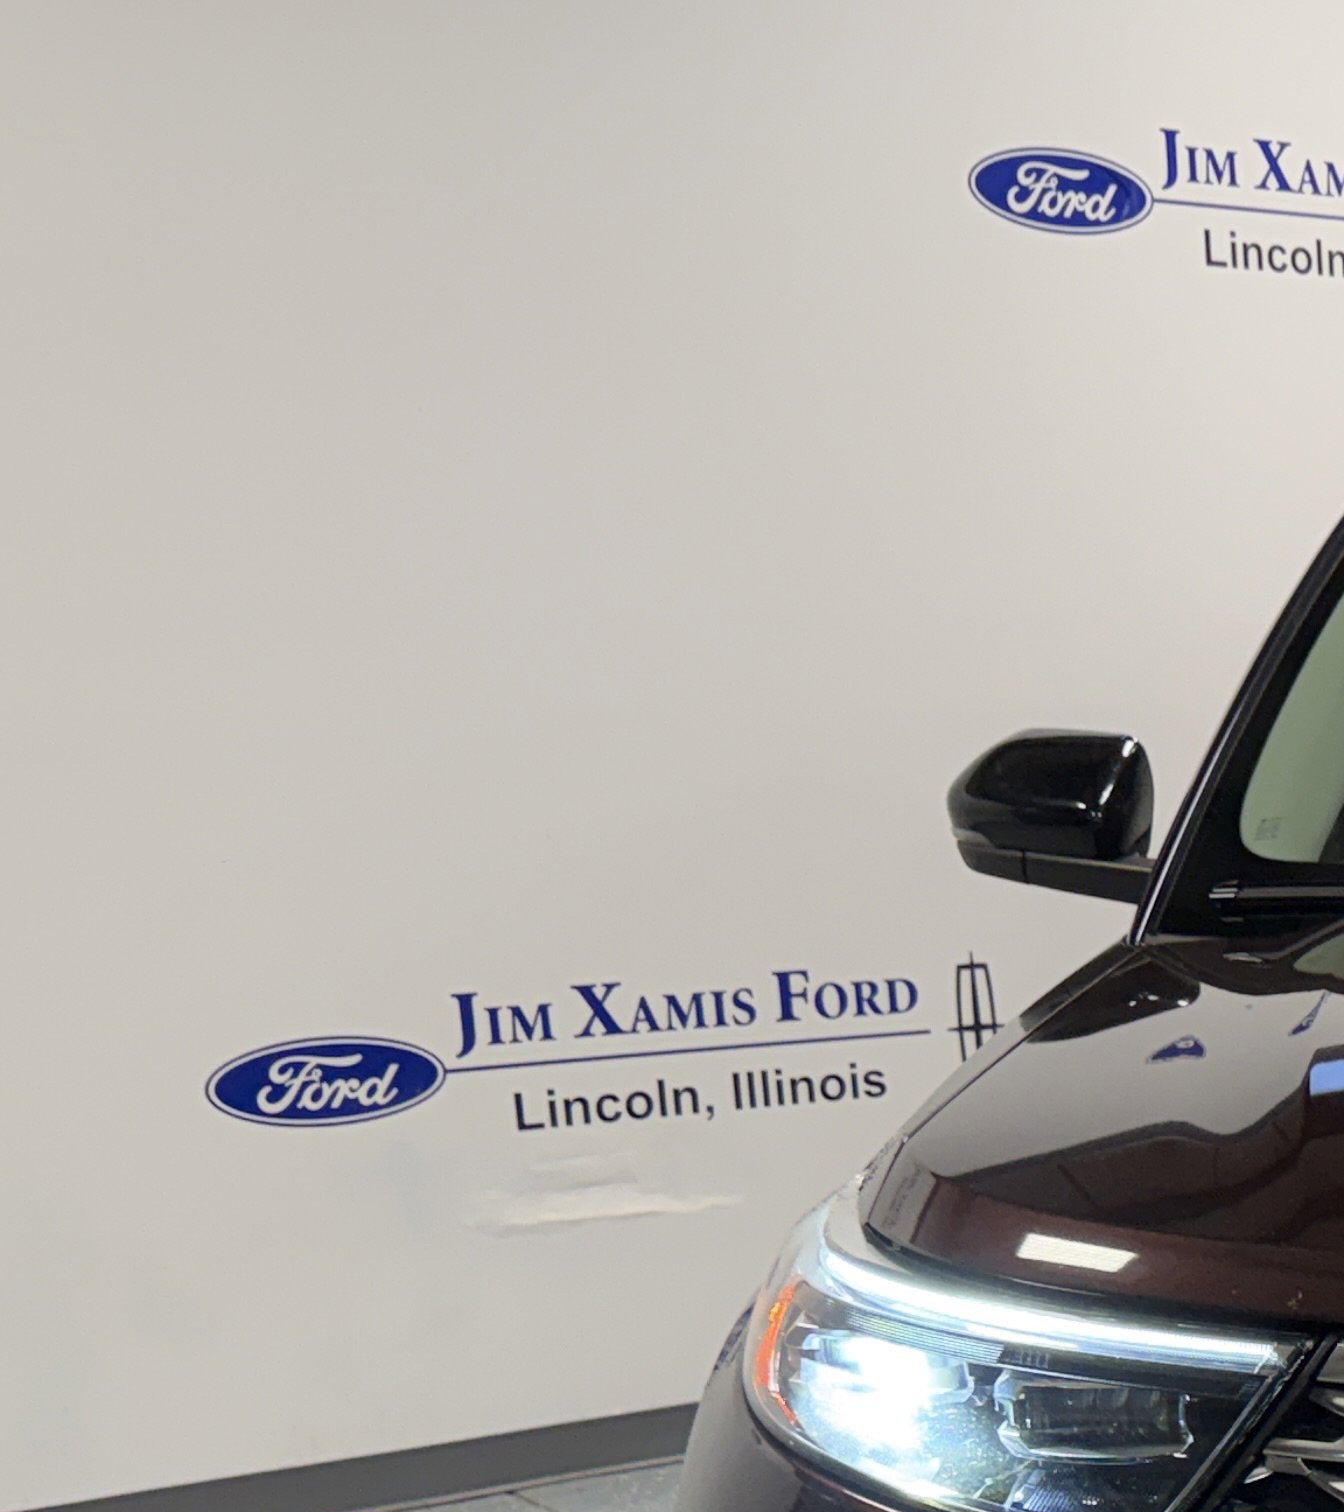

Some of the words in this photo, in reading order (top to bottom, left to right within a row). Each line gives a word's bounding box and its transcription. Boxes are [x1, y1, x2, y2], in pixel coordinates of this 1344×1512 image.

[1007, 160, 1118, 223] Ford
[257, 1054, 399, 1113] Ford
[514, 1079, 716, 1131] Lincoln,
[733, 1064, 887, 1112] Illinois
